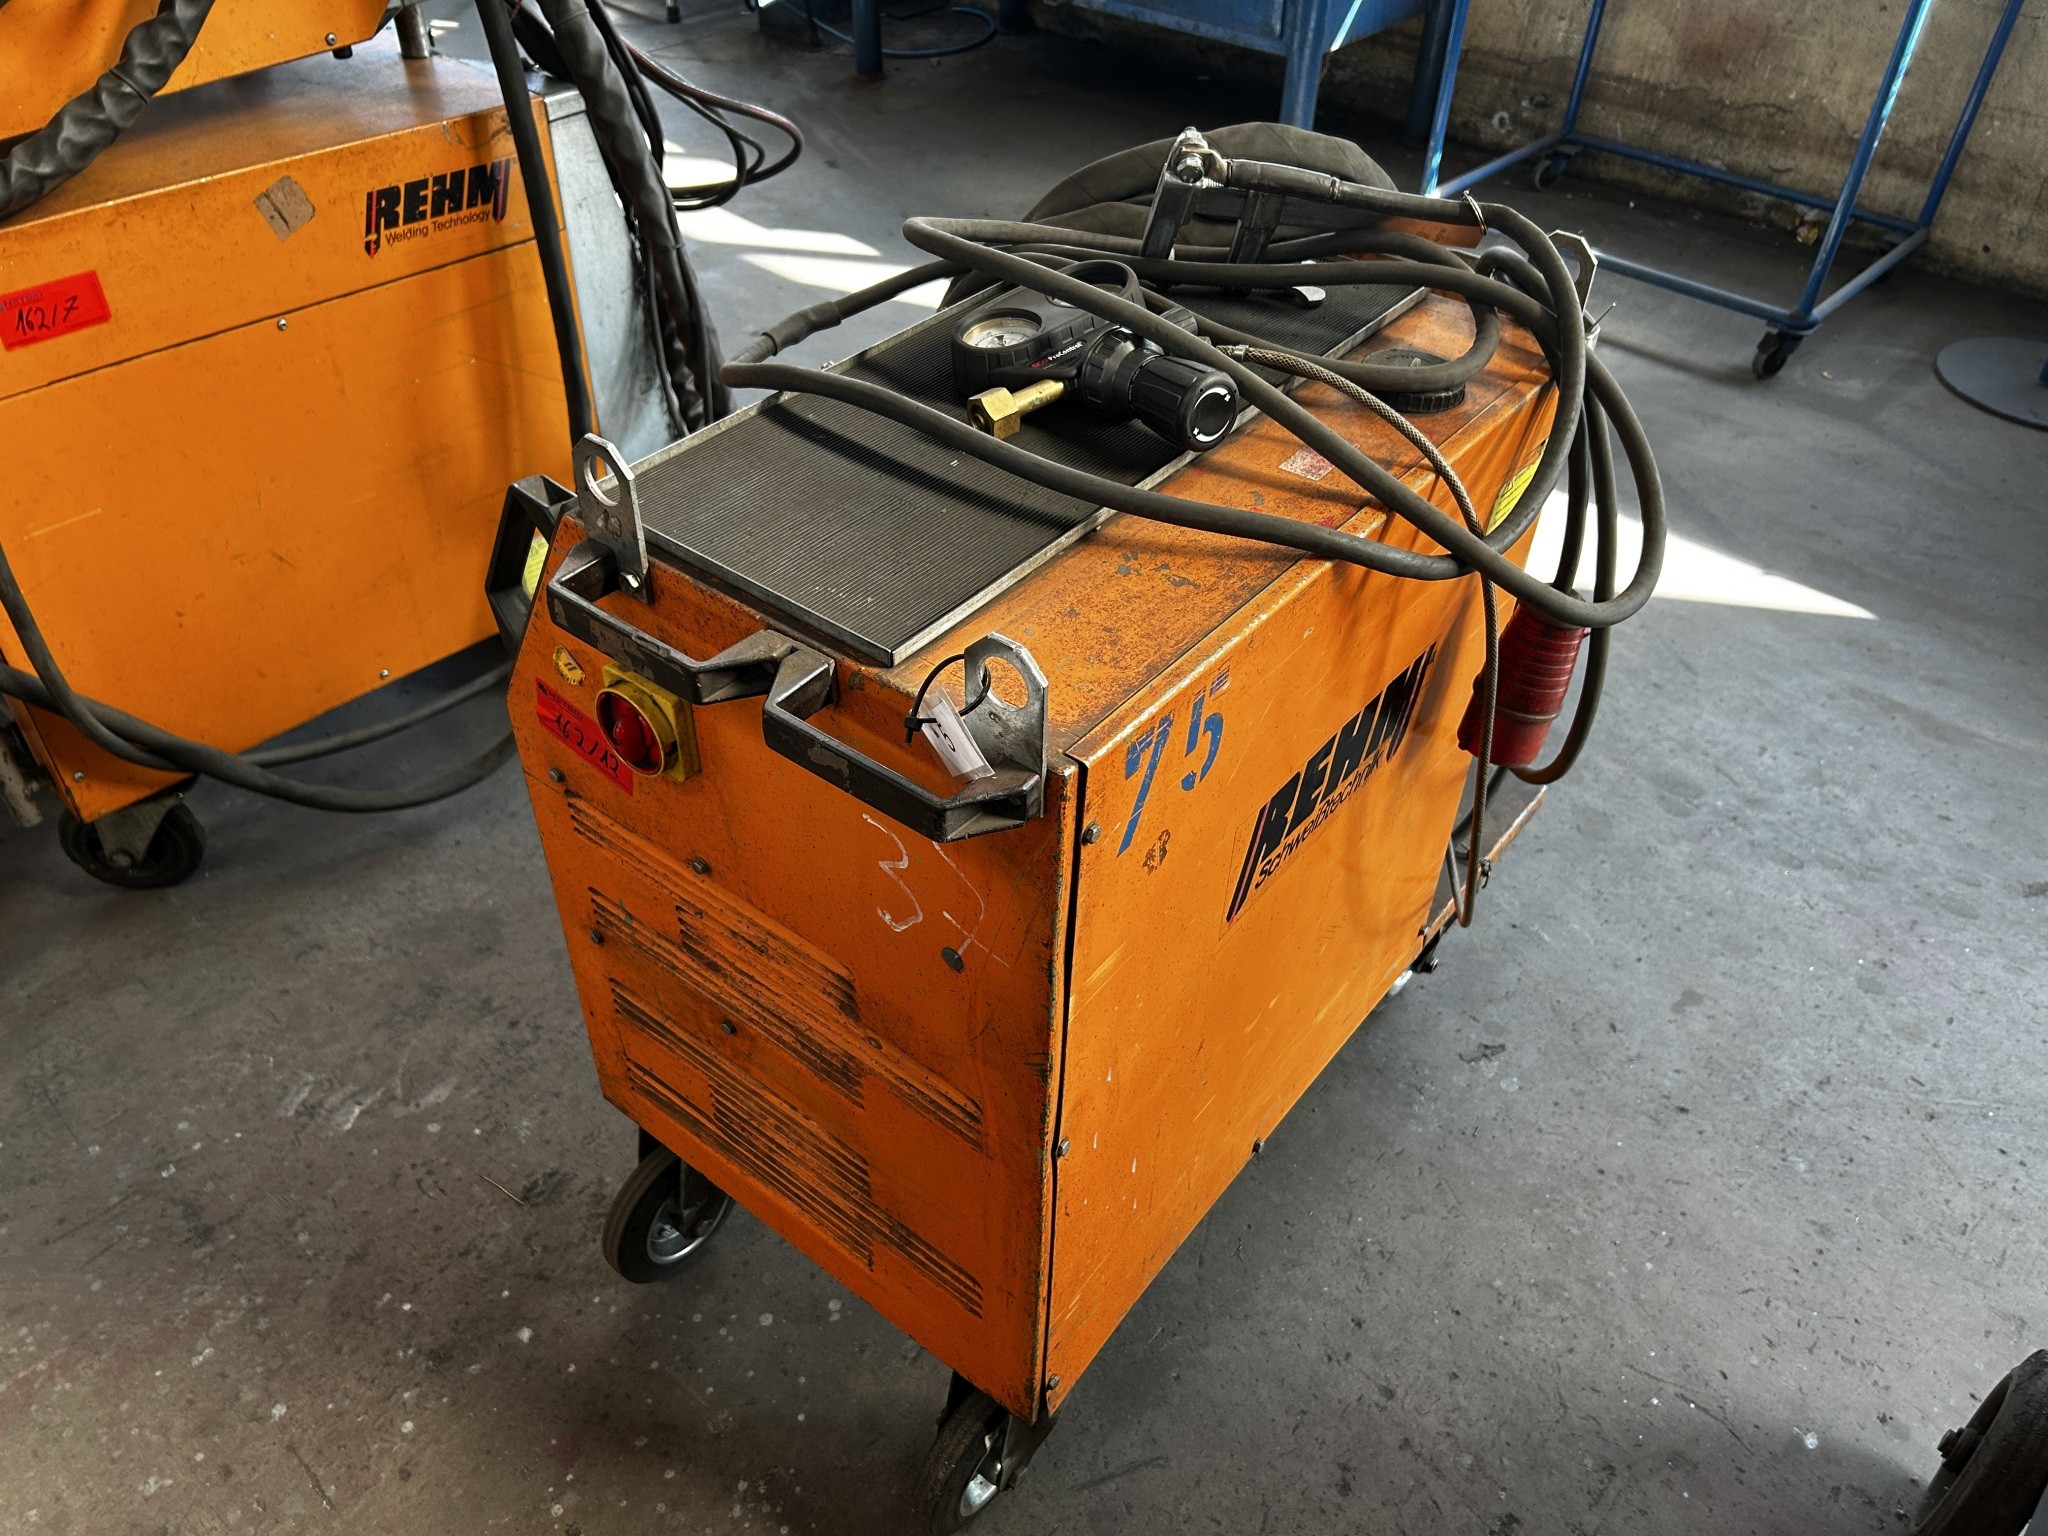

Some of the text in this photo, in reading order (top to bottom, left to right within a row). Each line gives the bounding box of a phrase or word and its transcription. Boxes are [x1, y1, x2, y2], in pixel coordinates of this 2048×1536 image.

[365, 157, 511, 259] REHM
[384, 208, 491, 245] Welding Technology
[15, 294, 80, 336] 162/7
[1116, 664, 1231, 859] 75
[1226, 641, 1437, 925] REHM
